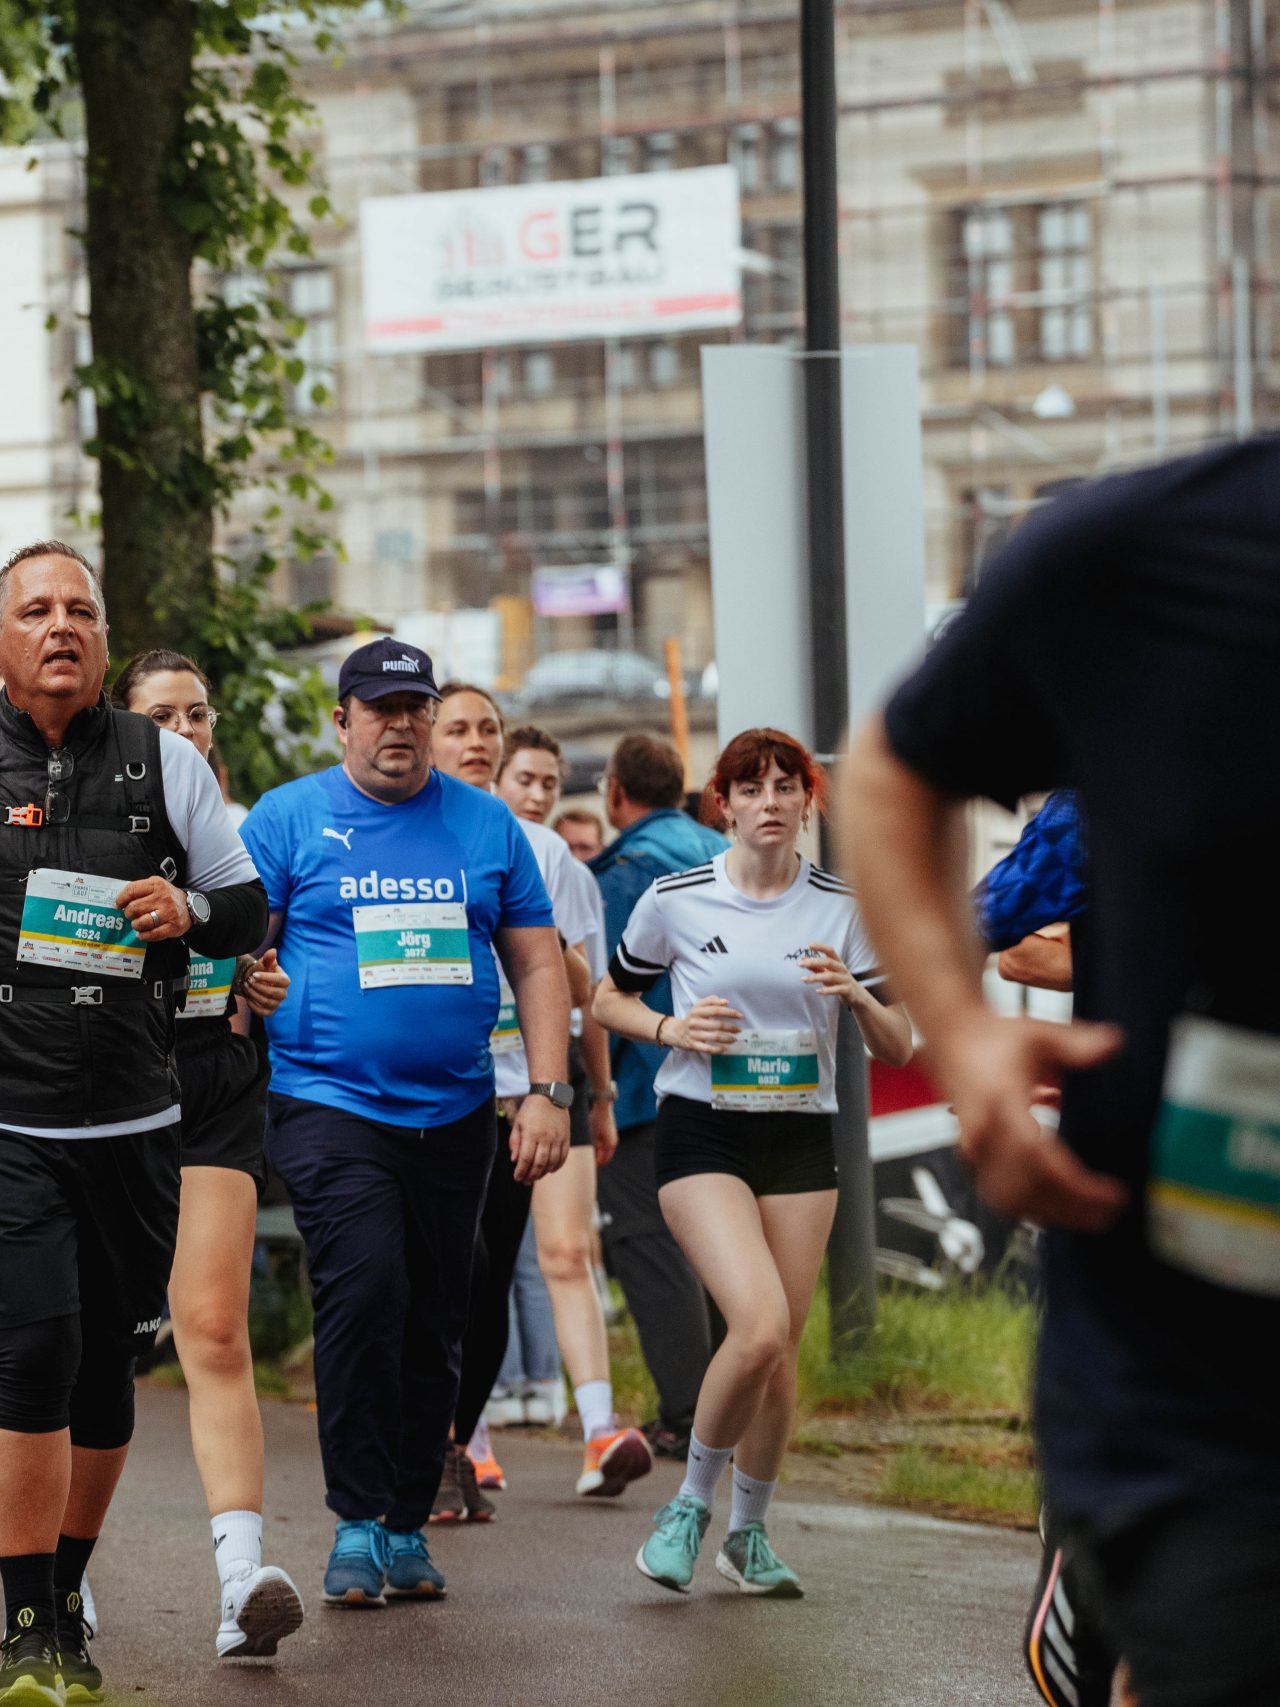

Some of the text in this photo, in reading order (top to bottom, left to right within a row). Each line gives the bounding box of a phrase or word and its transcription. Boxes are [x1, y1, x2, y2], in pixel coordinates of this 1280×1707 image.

[519, 202, 659, 262] GER
[382, 660, 417, 673] PUMA
[340, 870, 454, 900] adesso
[53, 904, 124, 931] Andreas
[75, 928, 101, 941] 4524
[397, 931, 431, 949] Jörg
[189, 962, 214, 976] nna
[747, 1058, 790, 1074] Marie
